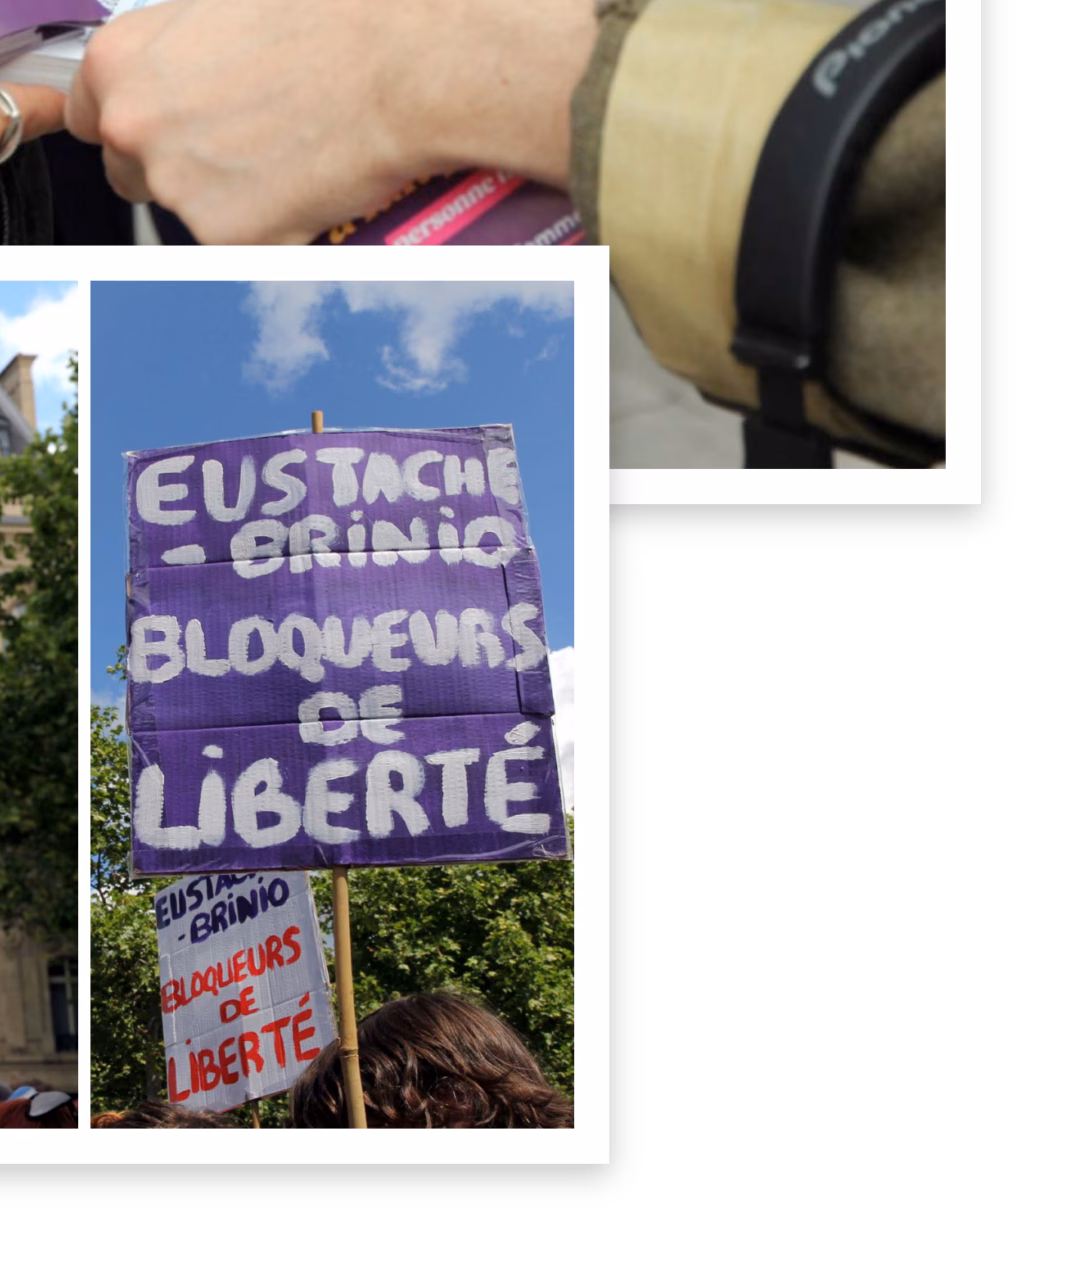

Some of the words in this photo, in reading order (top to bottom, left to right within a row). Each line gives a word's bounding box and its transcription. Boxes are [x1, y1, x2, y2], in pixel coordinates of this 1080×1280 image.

[136, 446, 520, 525] EUSTACHE
[128, 602, 549, 684] BLOQUEURS
[298, 684, 407, 746] DE
[161, 925, 302, 1014] BLOQUEURS
[220, 985, 260, 1024] DE
